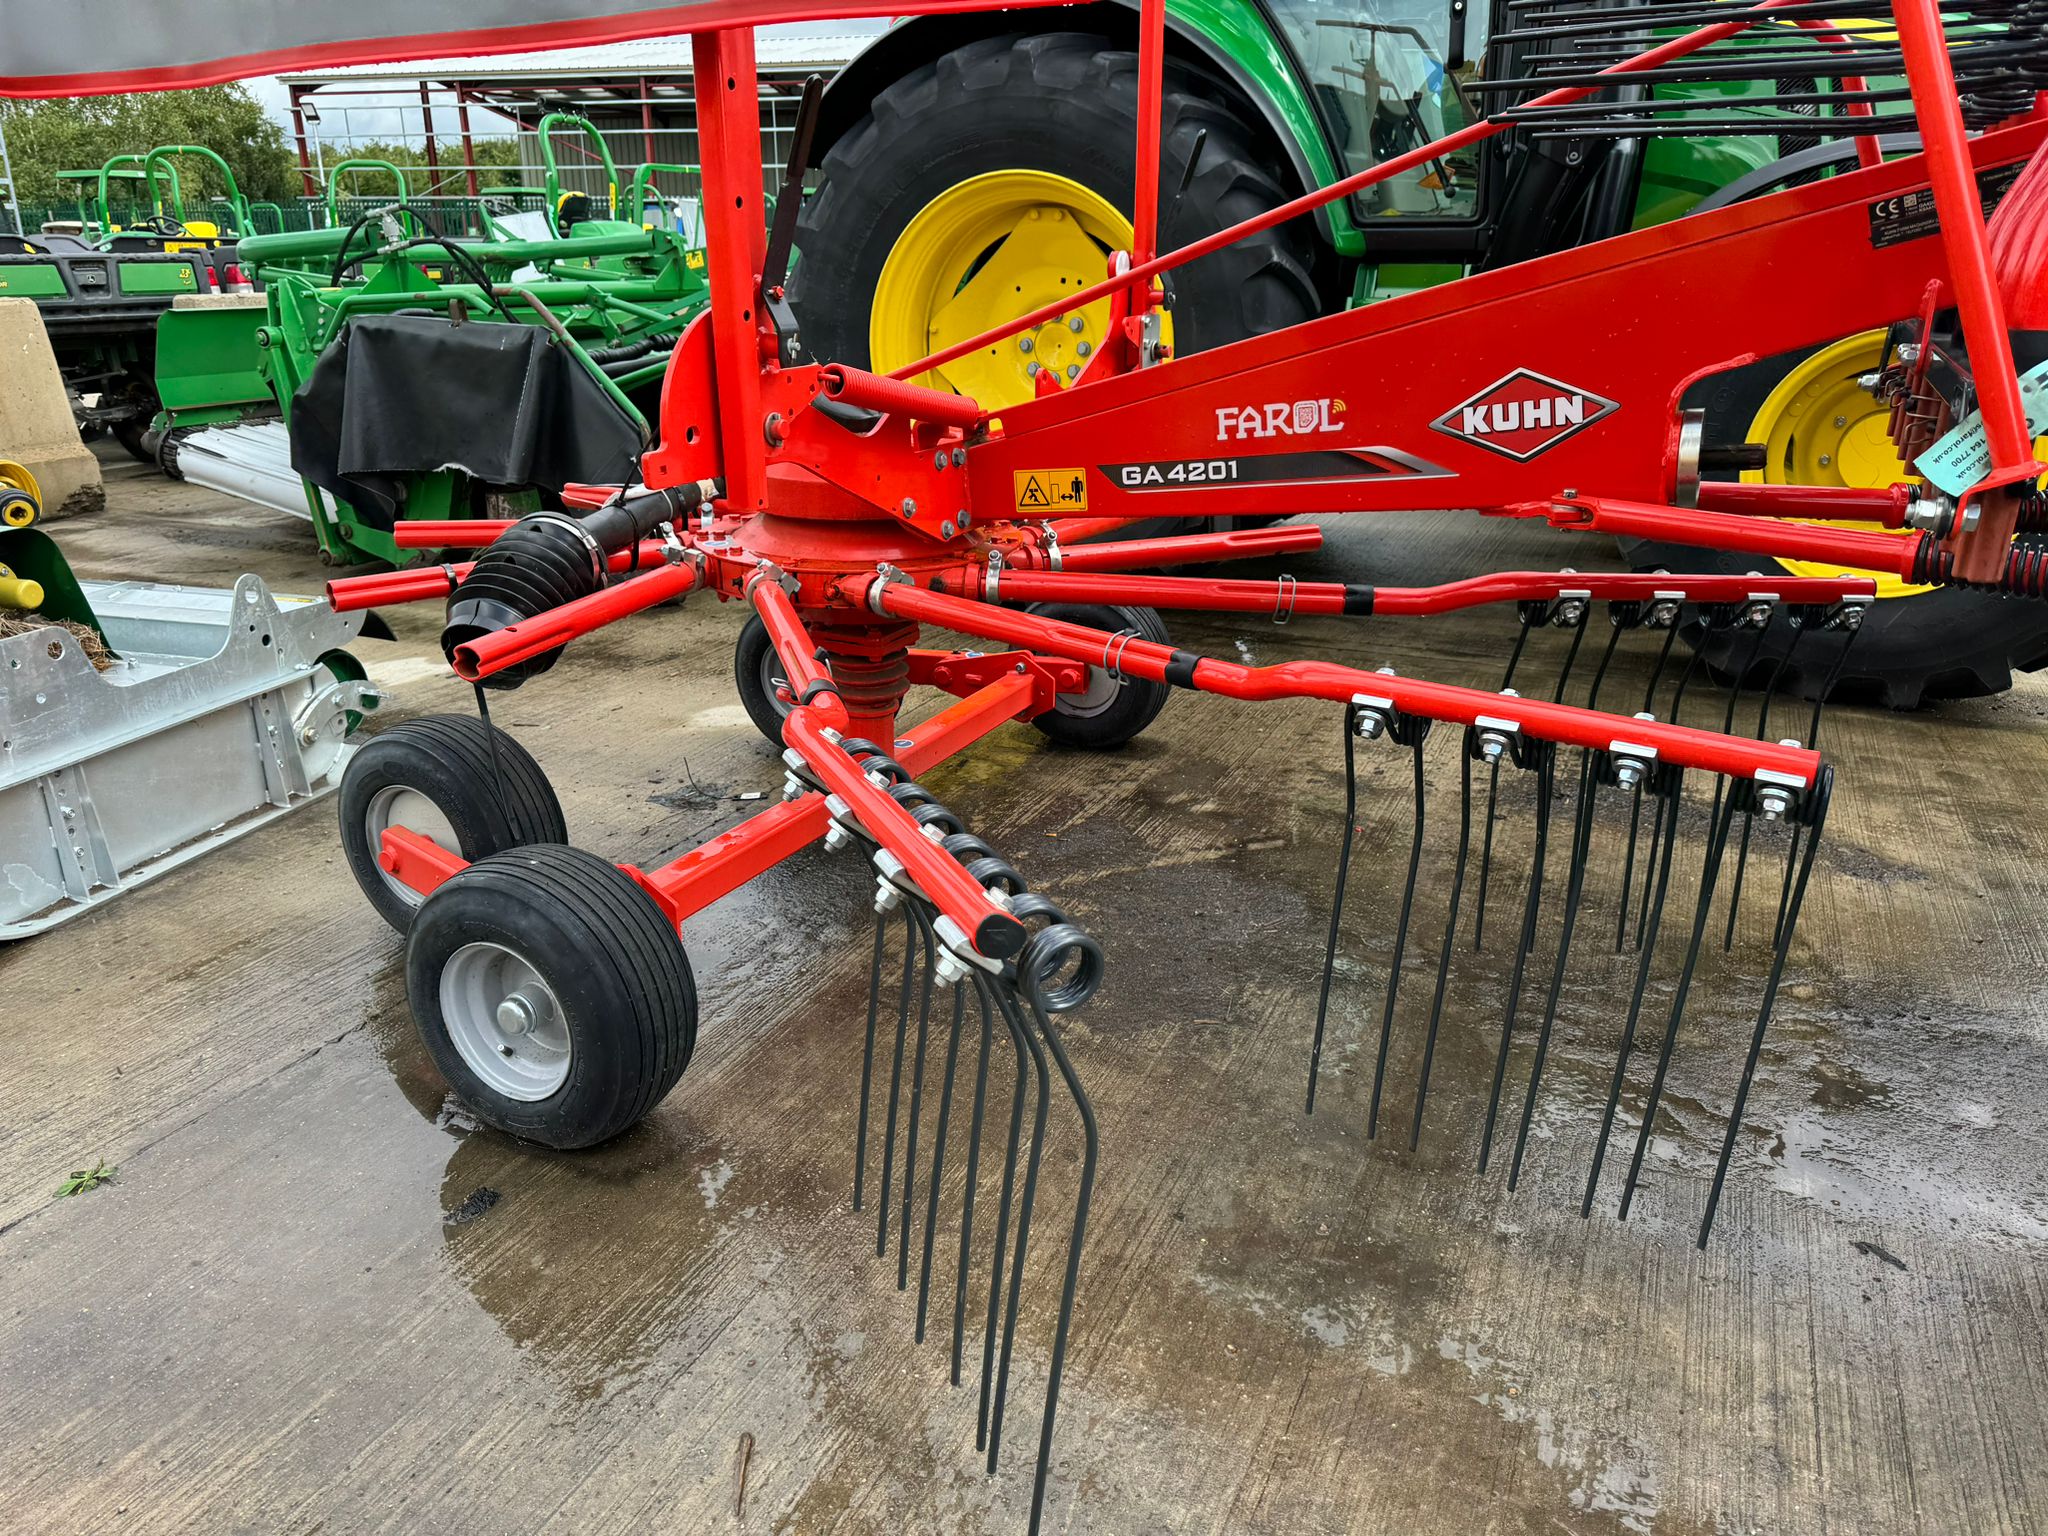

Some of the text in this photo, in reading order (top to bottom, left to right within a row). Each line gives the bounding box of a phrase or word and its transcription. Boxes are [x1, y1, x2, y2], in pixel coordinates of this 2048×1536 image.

[1876, 198, 1900, 217] CE
[1215, 399, 1345, 440] FAROL
[1463, 395, 1584, 435] KUHN
[1121, 460, 1239, 485] GA 4201
[1951, 450, 1972, 468] 7700
[1955, 449, 1990, 480] arol.co.uk
